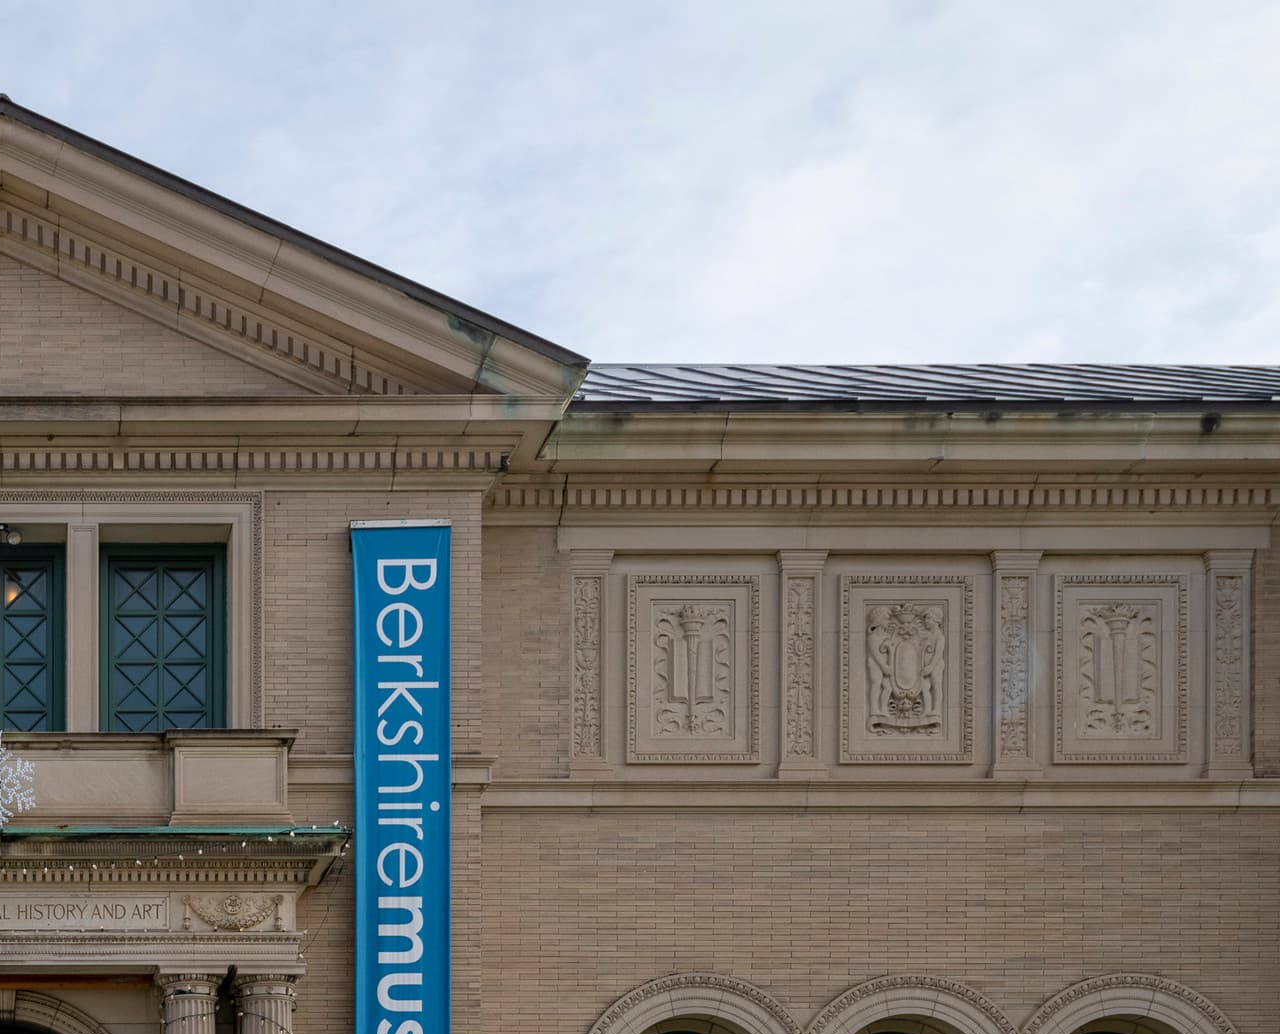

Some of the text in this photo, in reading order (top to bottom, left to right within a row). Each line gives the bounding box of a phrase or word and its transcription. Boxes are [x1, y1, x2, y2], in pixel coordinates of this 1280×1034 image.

[17, 903, 88, 920] HISTORY
[91, 903, 126, 920] AND
[131, 903, 163, 920] ART
